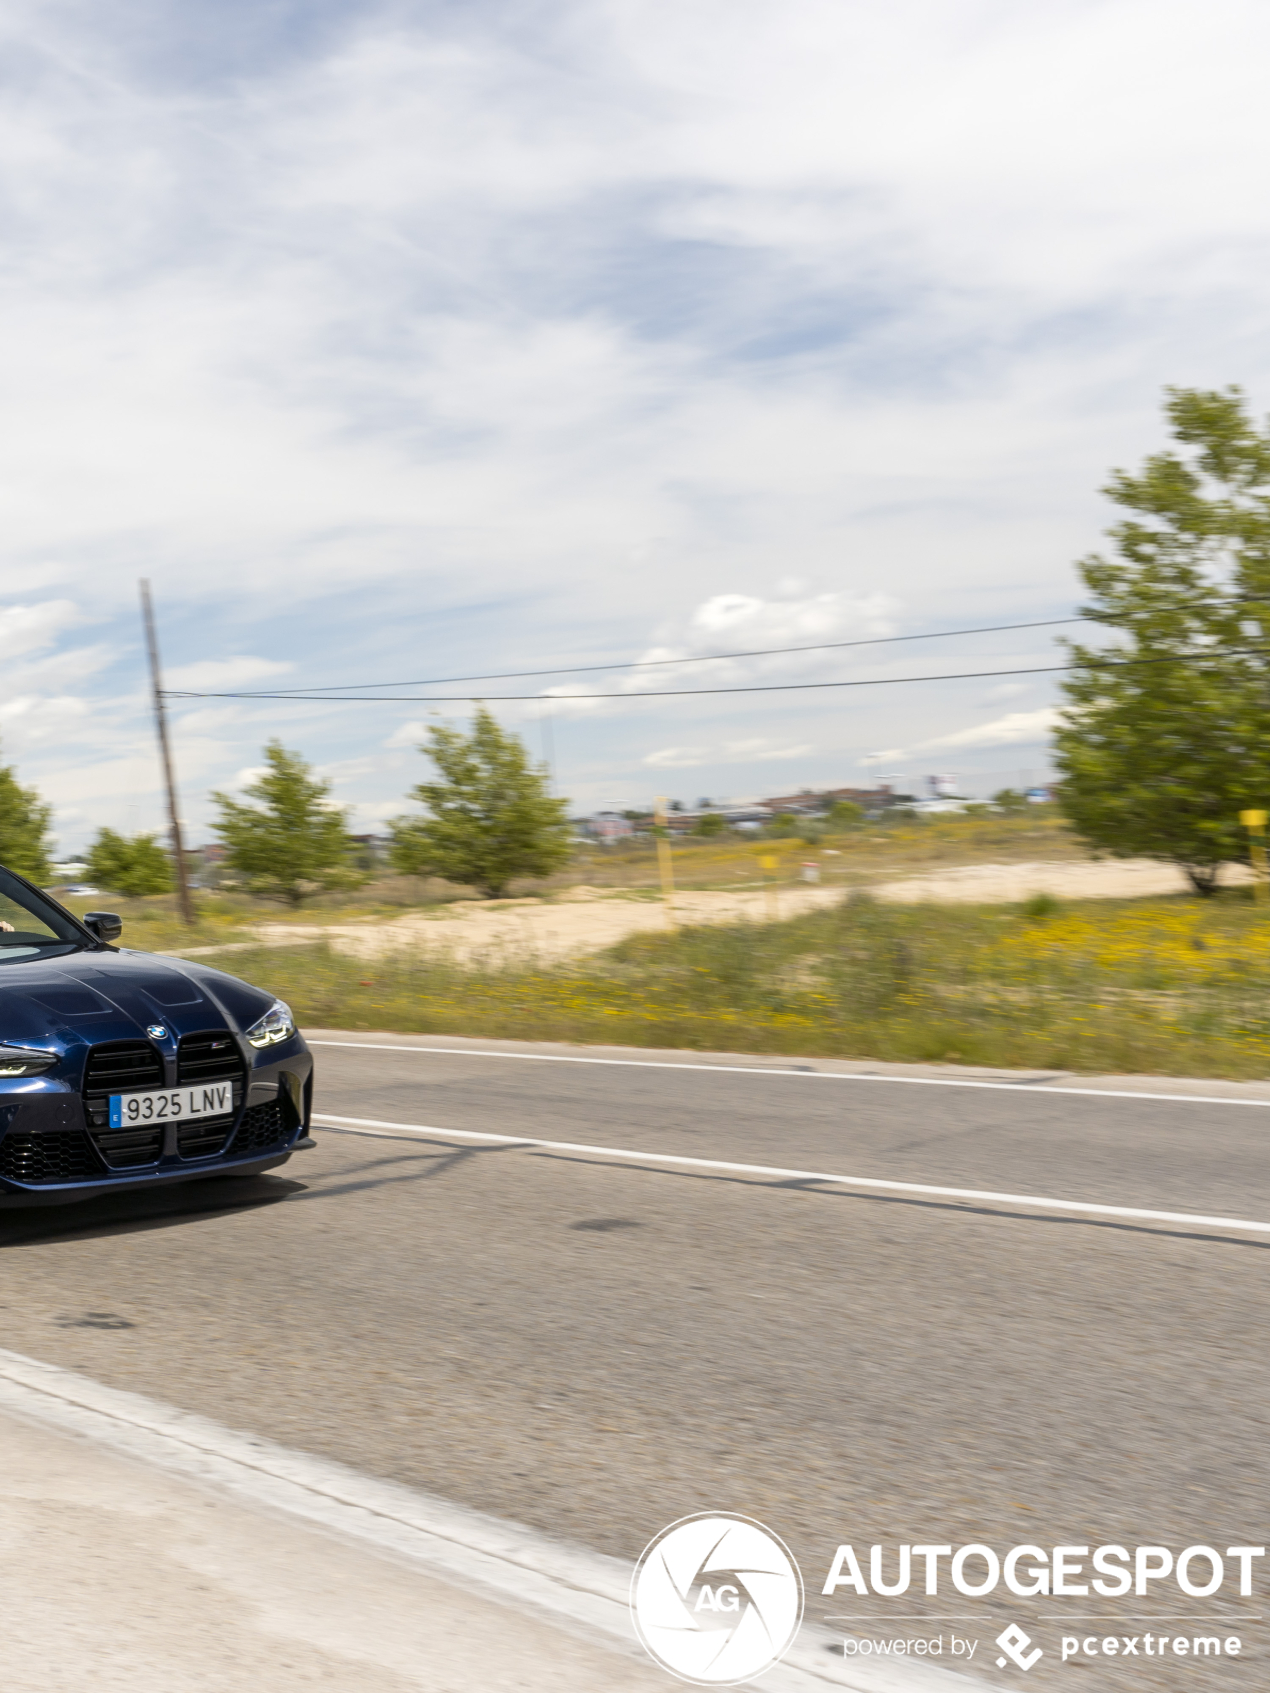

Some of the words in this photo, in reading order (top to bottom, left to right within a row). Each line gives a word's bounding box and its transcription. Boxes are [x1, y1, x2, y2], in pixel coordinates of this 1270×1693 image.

[127, 1093, 182, 1121] 9325
[190, 1086, 226, 1113] LNV
[112, 1114, 119, 1122] E
